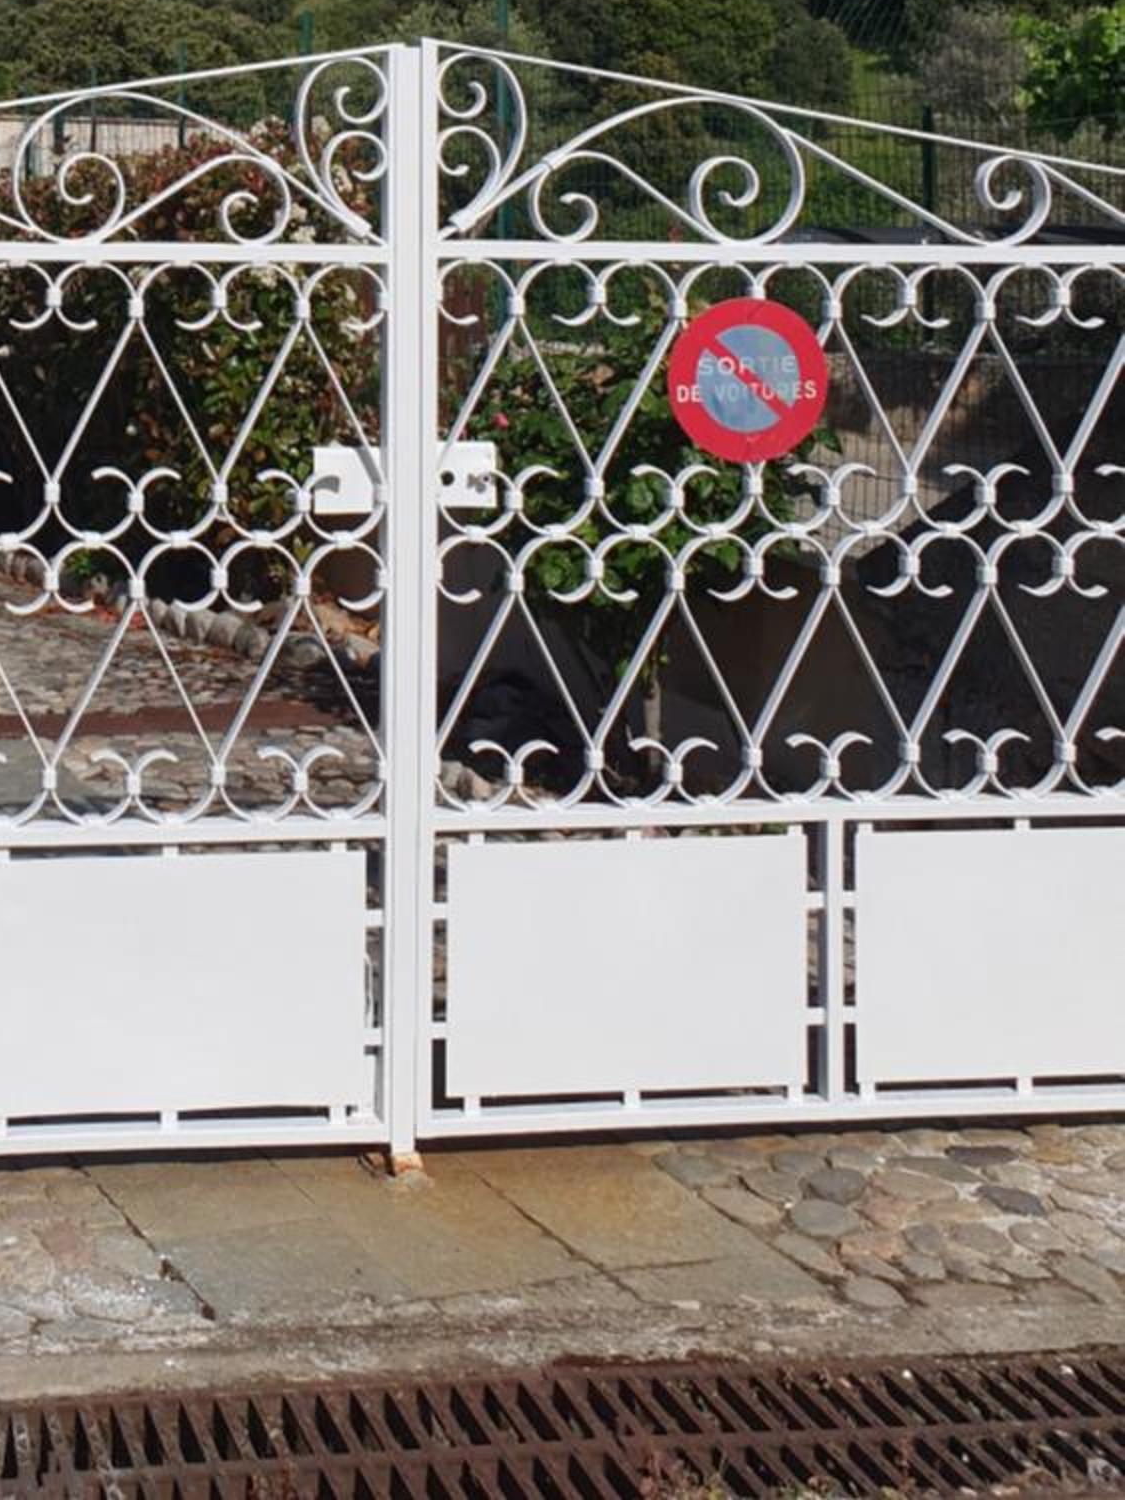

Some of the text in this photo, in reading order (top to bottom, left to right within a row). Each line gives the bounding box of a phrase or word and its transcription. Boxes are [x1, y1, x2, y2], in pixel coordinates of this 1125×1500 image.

[698, 356, 797, 375] SORTIE
[676, 380, 818, 403] DE VOITURES
